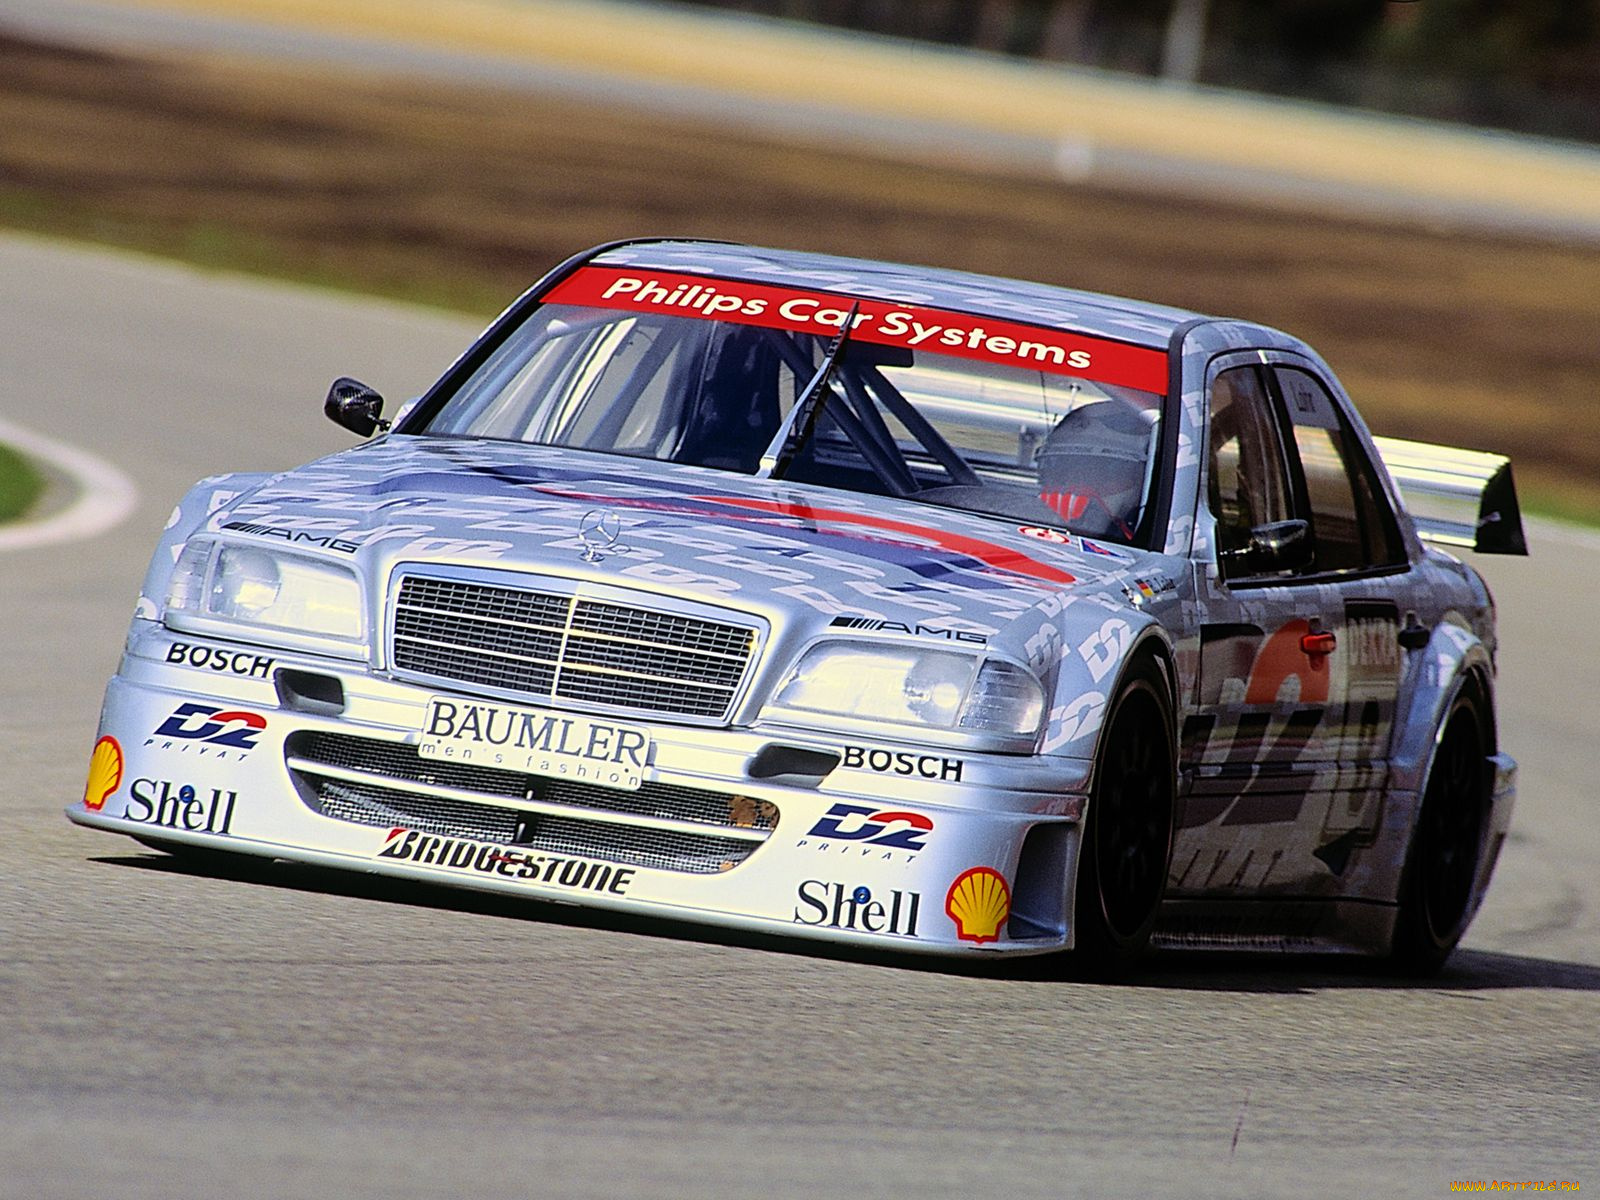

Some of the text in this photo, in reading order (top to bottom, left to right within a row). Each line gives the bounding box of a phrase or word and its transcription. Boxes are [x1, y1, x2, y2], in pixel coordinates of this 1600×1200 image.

[601, 277, 1092, 370] Philips Car Systems
[260, 528, 359, 554] AMG
[874, 620, 989, 645] AMG
[165, 641, 276, 679] BOSCH
[152, 702, 268, 750] D2
[426, 700, 648, 768] BÄUMLER
[144, 738, 249, 762] PRIVAT
[525, 755, 640, 787] fashion
[842, 745, 964, 783] BOSCH
[122, 777, 239, 835] Shell
[806, 802, 934, 851] D2
[377, 826, 636, 895] BRIDGESTONE
[796, 839, 917, 864] PRIVAT
[793, 879, 920, 938] Shell
